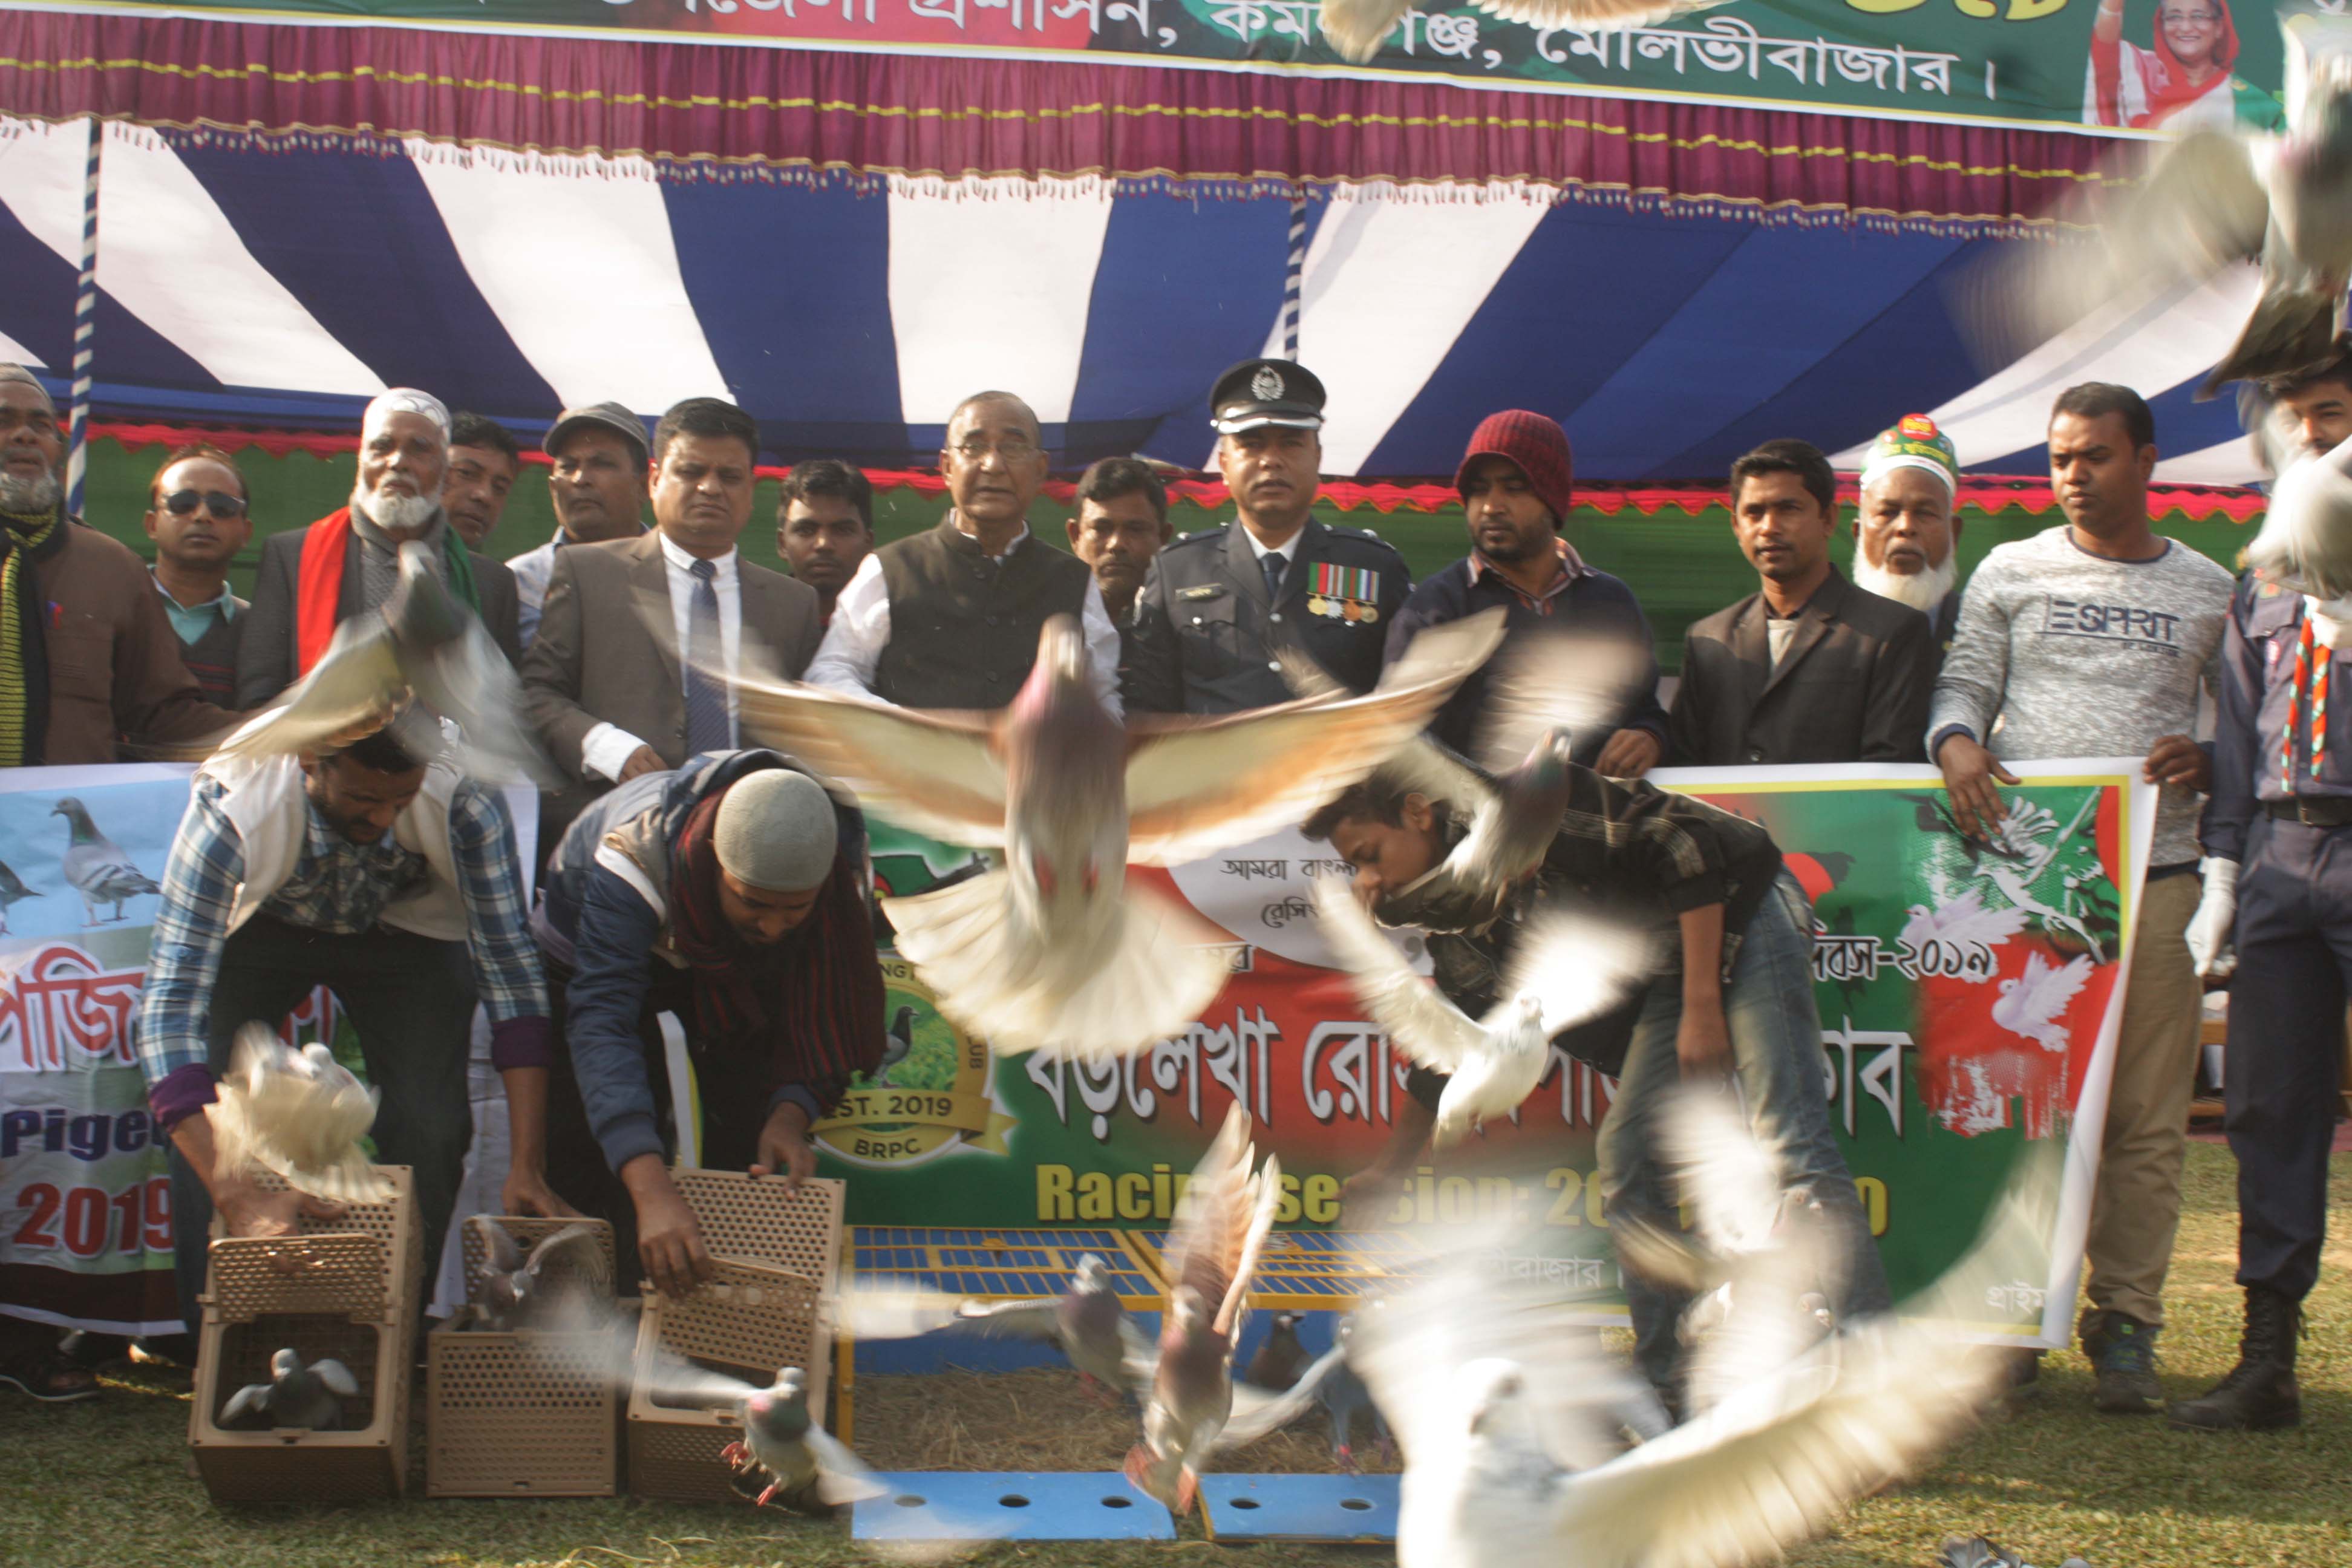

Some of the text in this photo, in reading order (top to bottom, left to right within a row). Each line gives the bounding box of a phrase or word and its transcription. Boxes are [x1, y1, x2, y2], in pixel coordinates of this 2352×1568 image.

[2051, 599, 2181, 642] ESPRIT
[1220, 858, 1289, 881] আমরা
[831, 1096, 953, 1119] ST. 2019
[1, 1109, 167, 1161] Pige
[853, 1138, 921, 1158] BRPC
[13, 1176, 175, 1256] 2019
